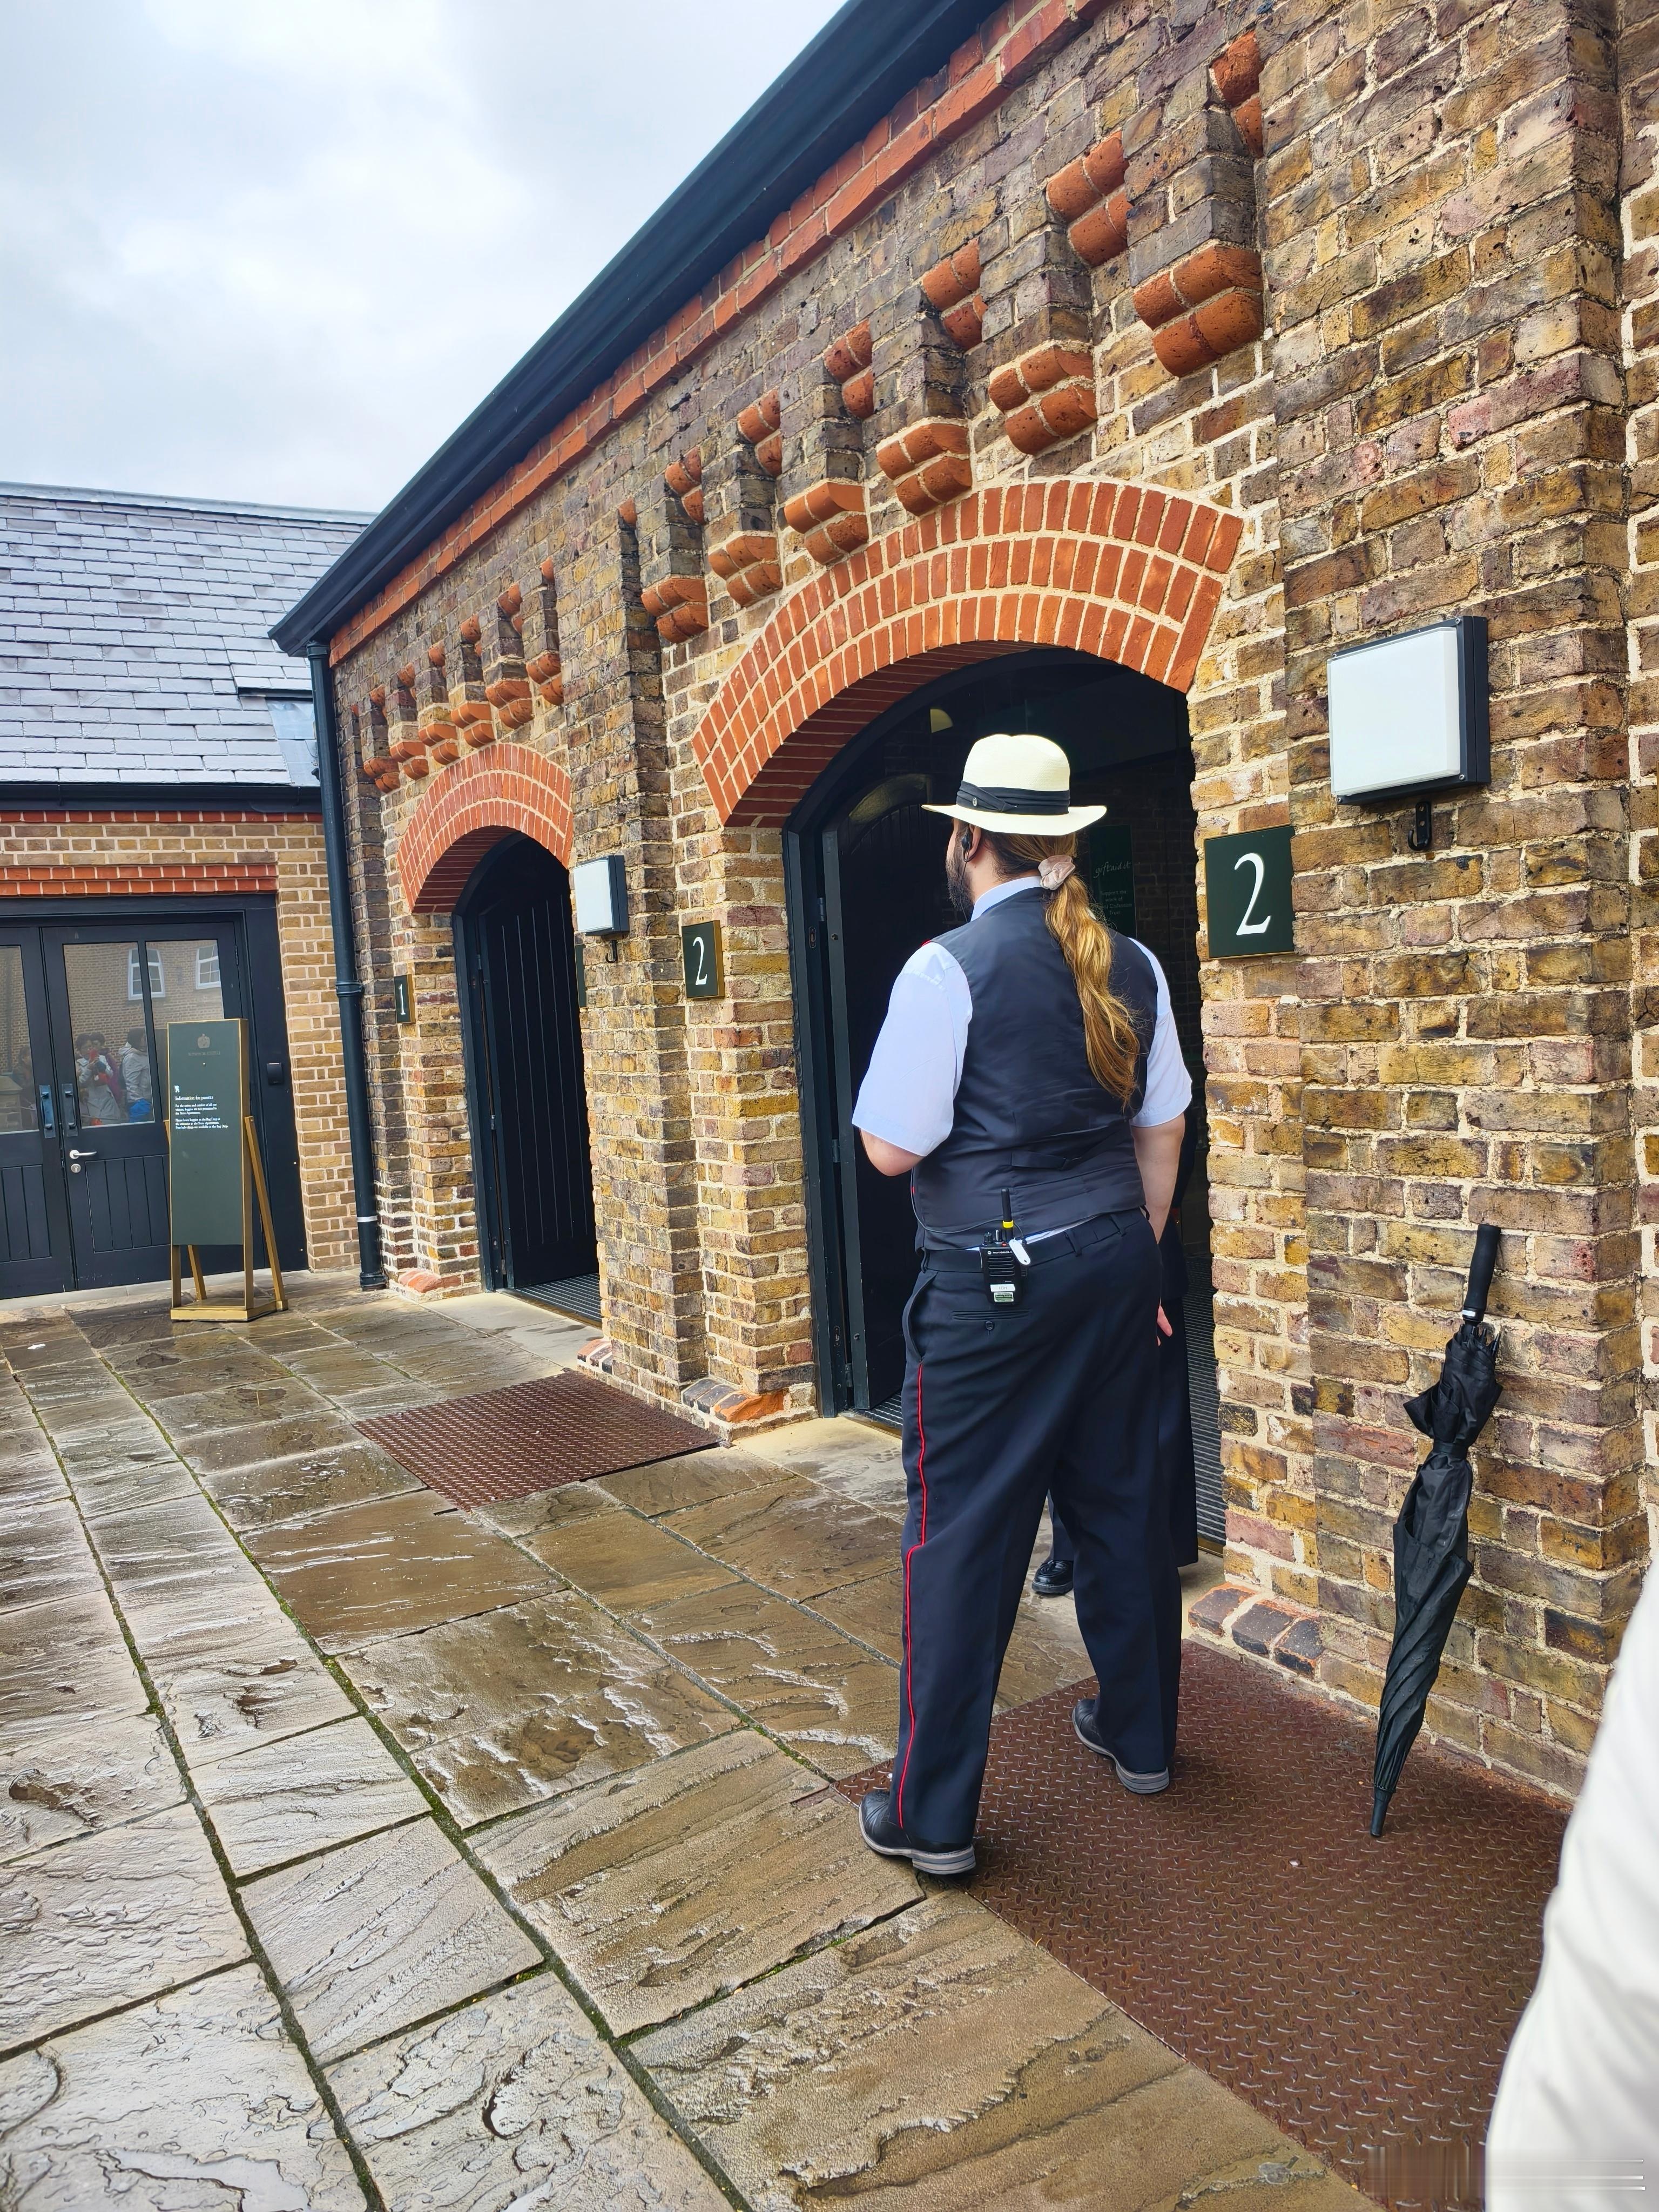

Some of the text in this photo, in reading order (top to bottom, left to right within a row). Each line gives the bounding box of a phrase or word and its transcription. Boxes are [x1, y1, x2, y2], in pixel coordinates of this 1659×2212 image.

[1234, 853, 1271, 935] 2
[693, 937, 707, 985] 2
[399, 983, 406, 1015] 1
